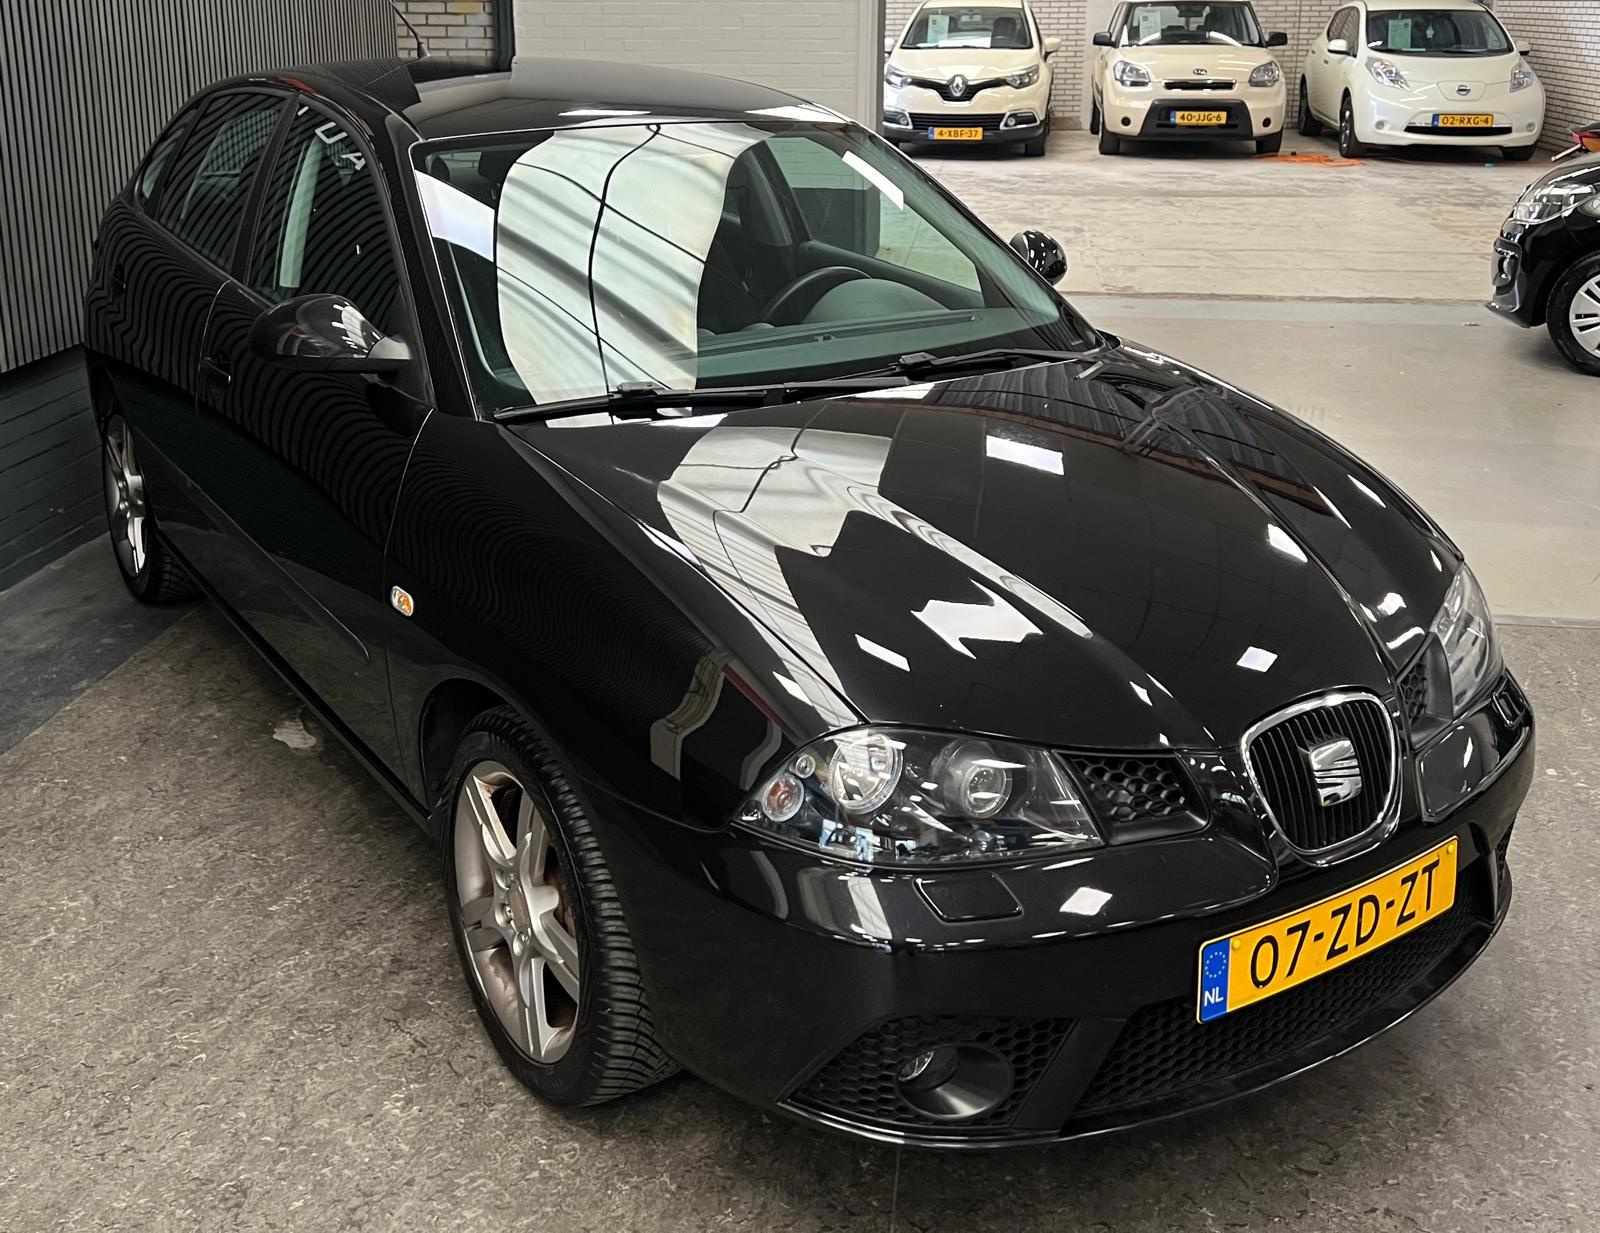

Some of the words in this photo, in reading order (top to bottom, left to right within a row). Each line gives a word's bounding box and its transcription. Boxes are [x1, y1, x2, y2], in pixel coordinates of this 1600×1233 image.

[1180, 113, 1222, 122] 40-JJG-6
[1442, 116, 1489, 126] 02-RXG-4
[938, 129, 979, 138] 4-XBF-37
[1250, 859, 1440, 989] 07-ZD-ZT
[1204, 986, 1224, 1007] NL
